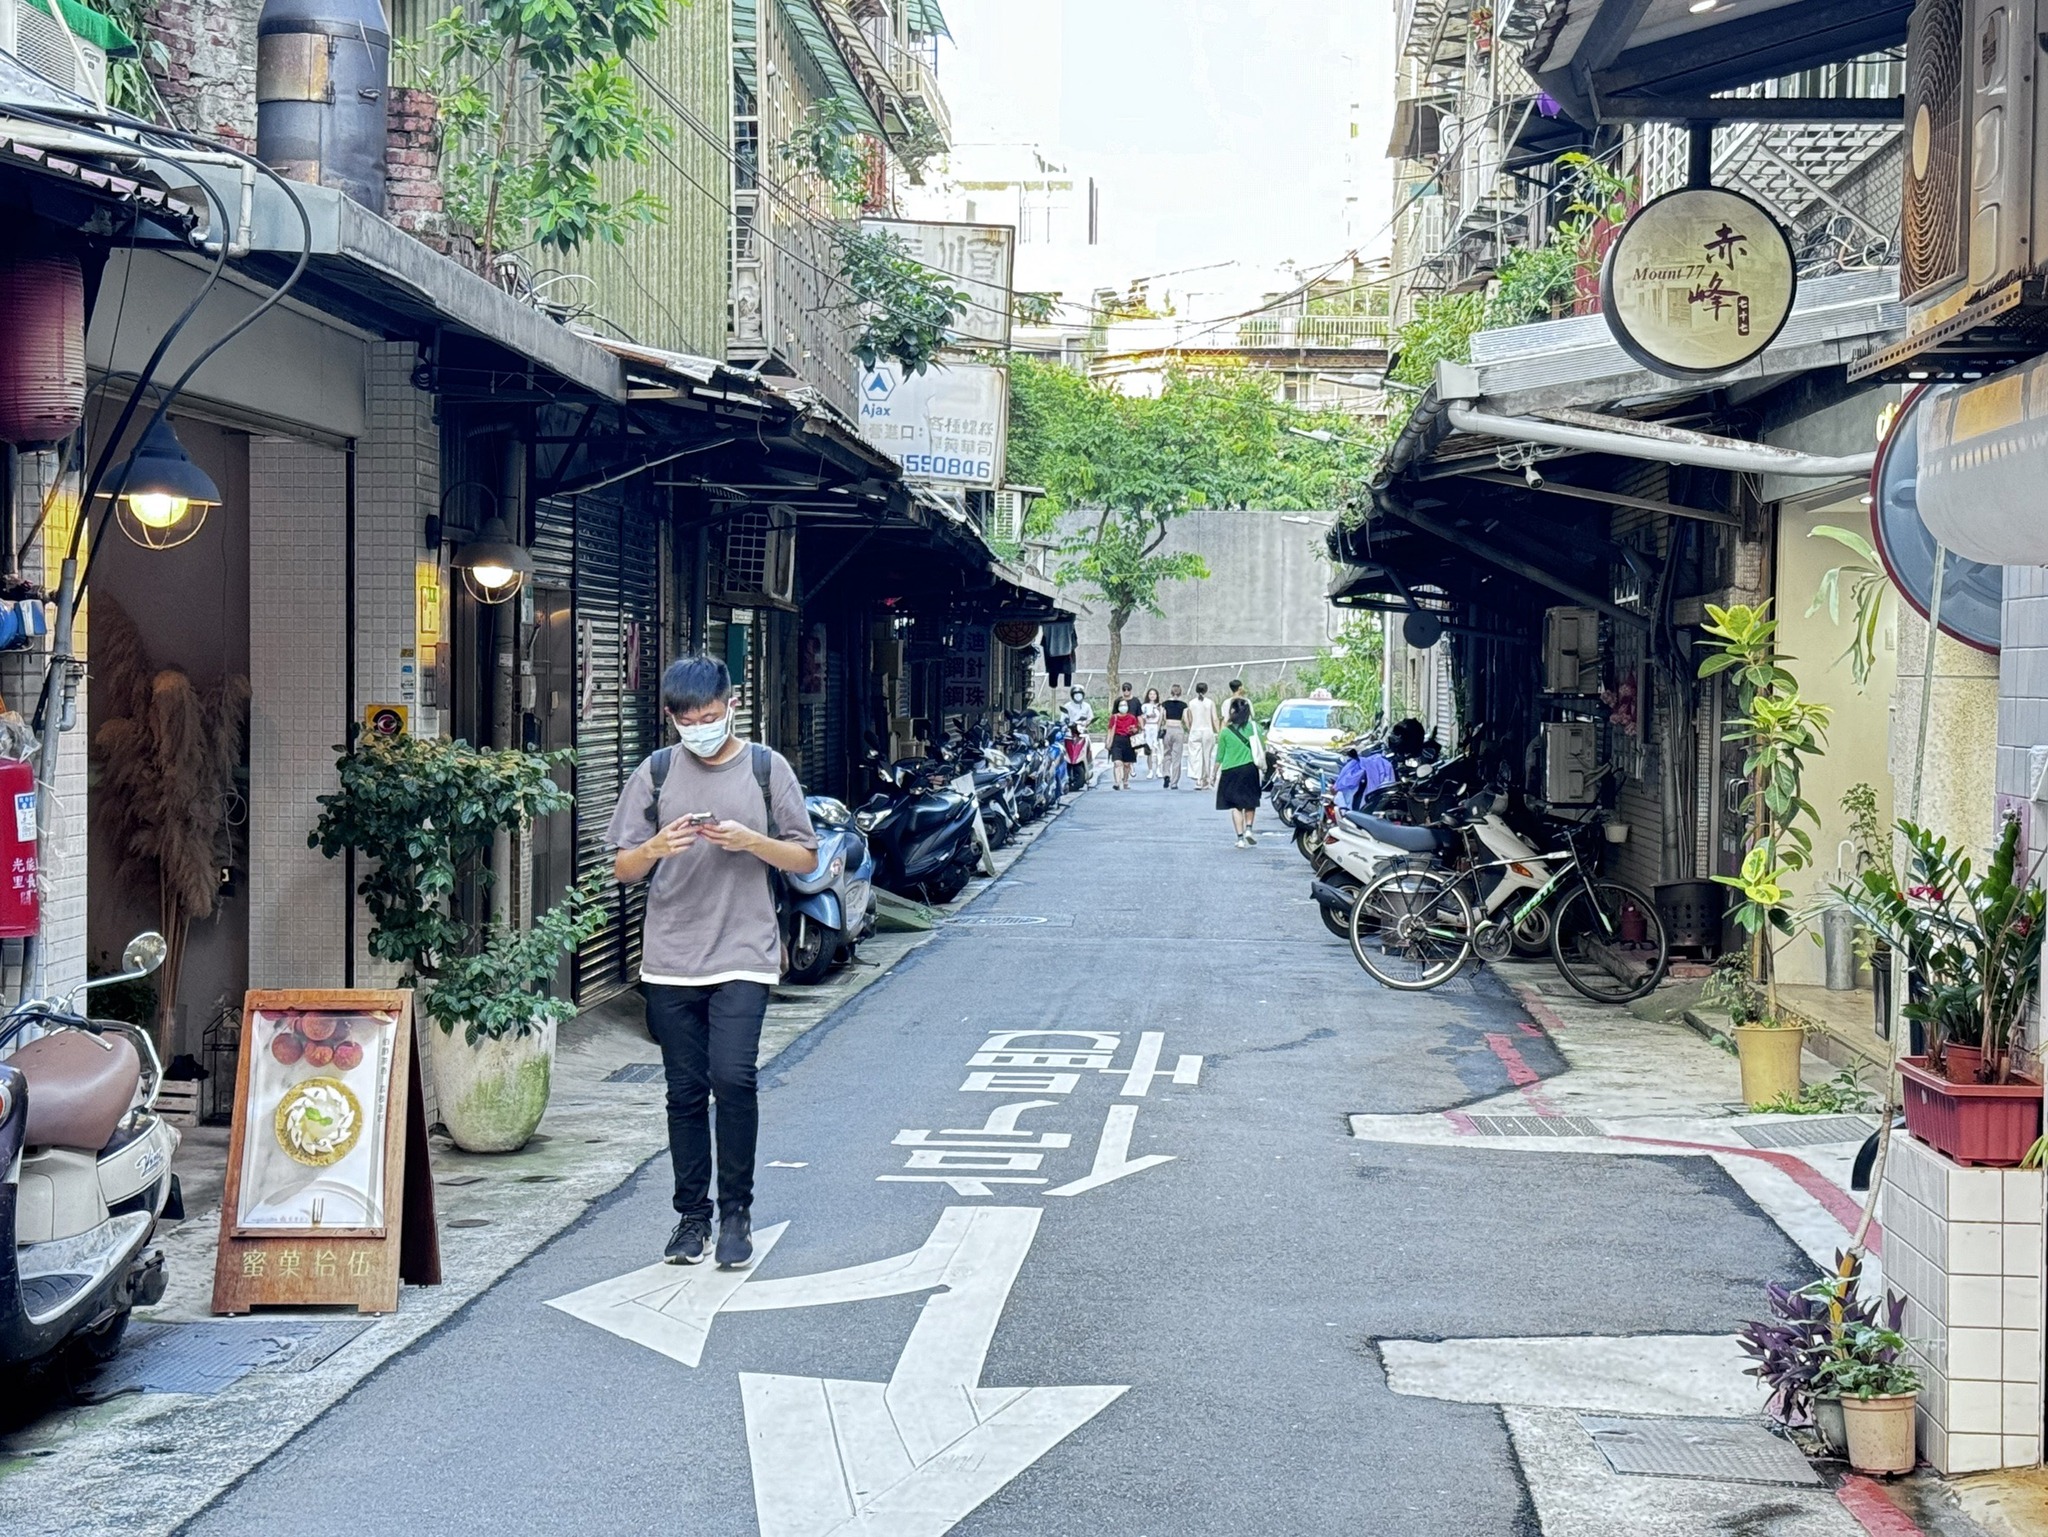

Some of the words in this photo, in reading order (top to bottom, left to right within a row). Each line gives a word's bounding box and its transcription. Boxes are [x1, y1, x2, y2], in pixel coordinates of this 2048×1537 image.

[1632, 268, 1682, 281] Mount
[1686, 265, 1706, 280] 77
[1688, 222, 1748, 322] 赤峰
[1738, 298, 1750, 333] 七十七
[861, 402, 891, 417] Ajax
[901, 454, 991, 478] 590846
[944, 656, 986, 679] 鋼針
[944, 685, 986, 708] 鋼珠
[12, 856, 38, 873] 光能
[242, 1249, 372, 1278] 蜜菓拾伍
